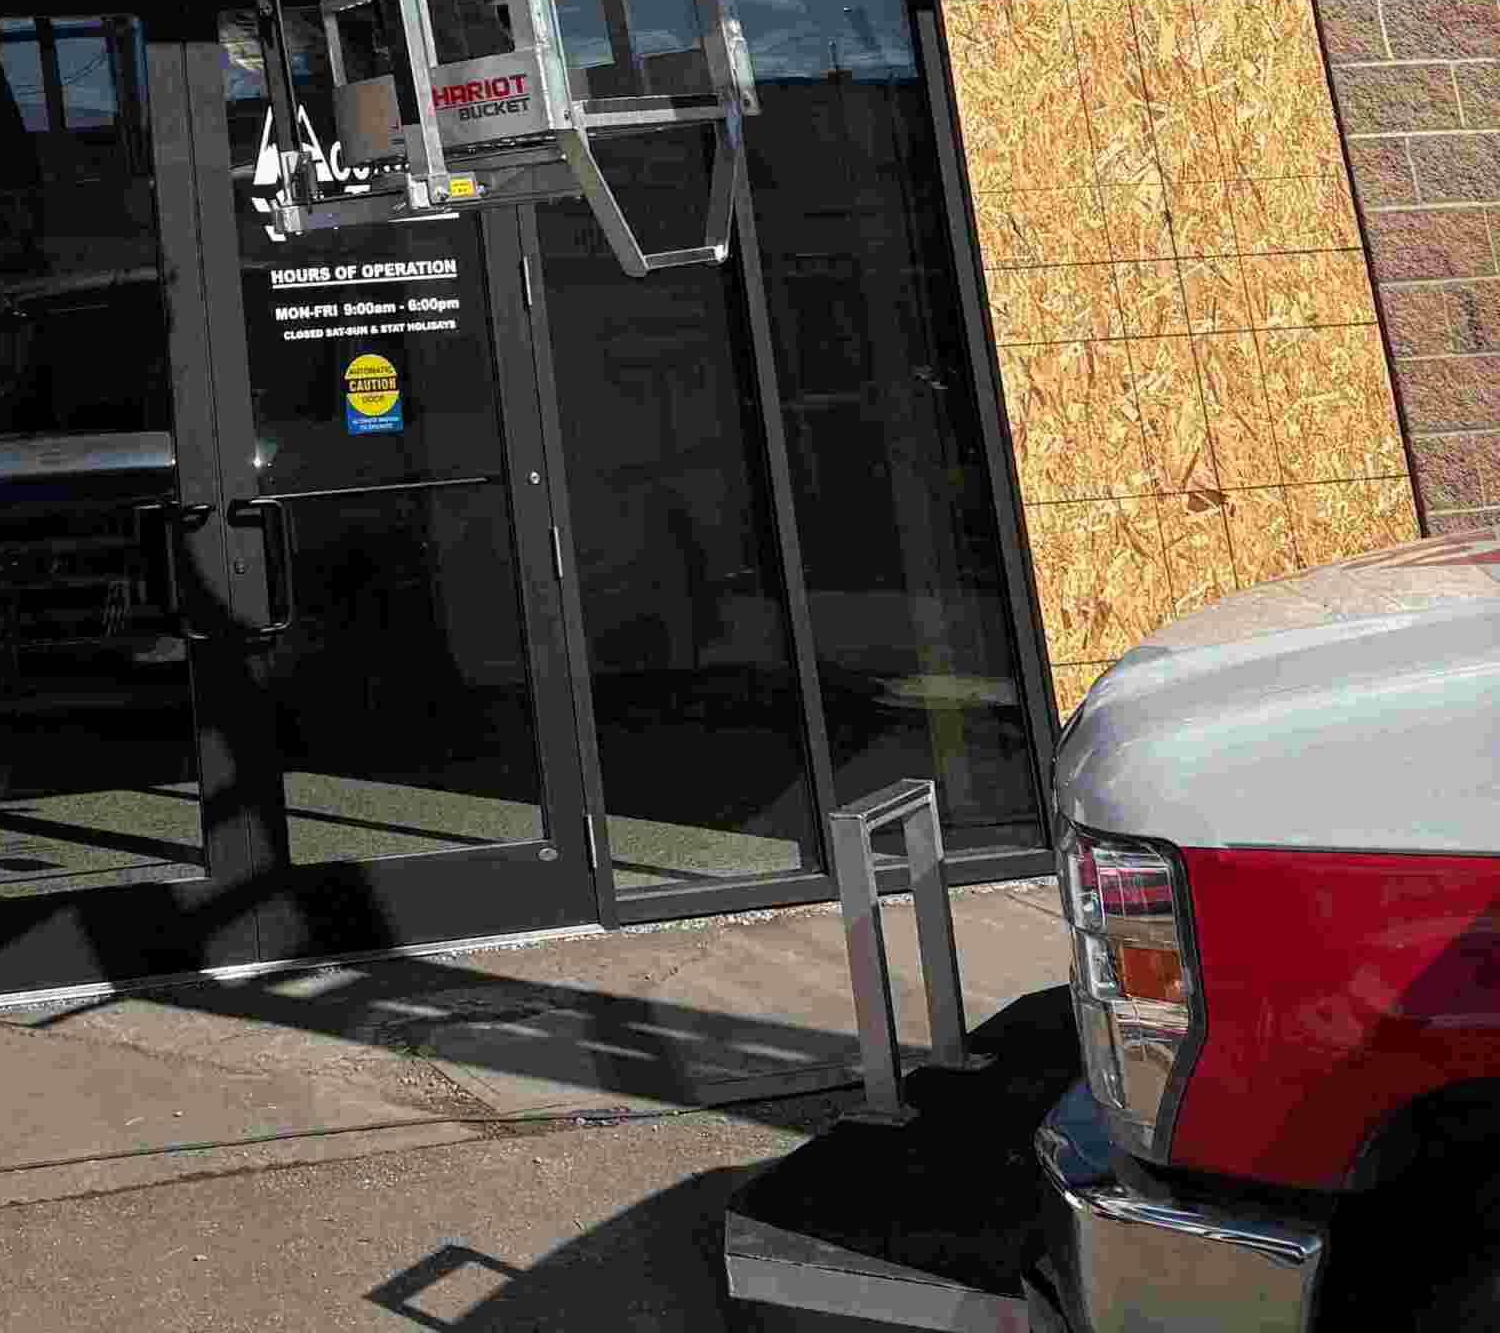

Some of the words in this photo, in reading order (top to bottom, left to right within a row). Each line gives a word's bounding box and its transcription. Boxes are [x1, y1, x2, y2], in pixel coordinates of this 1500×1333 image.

[459, 100, 529, 121] BUCKET
[271, 267, 331, 285] HOURS
[335, 266, 357, 280] OF
[362, 259, 457, 278] OPERATION
[275, 304, 338, 321] MON-FRI
[343, 301, 396, 317] 9:00am
[283, 329, 324, 341] CLOSED
[326, 326, 368, 338] SAT-SUN
[370, 325, 378, 334] &
[380, 322, 405, 334] STAT
[407, 319, 457, 332] HOLIDAYS
[348, 377, 397, 392] CAUTION
